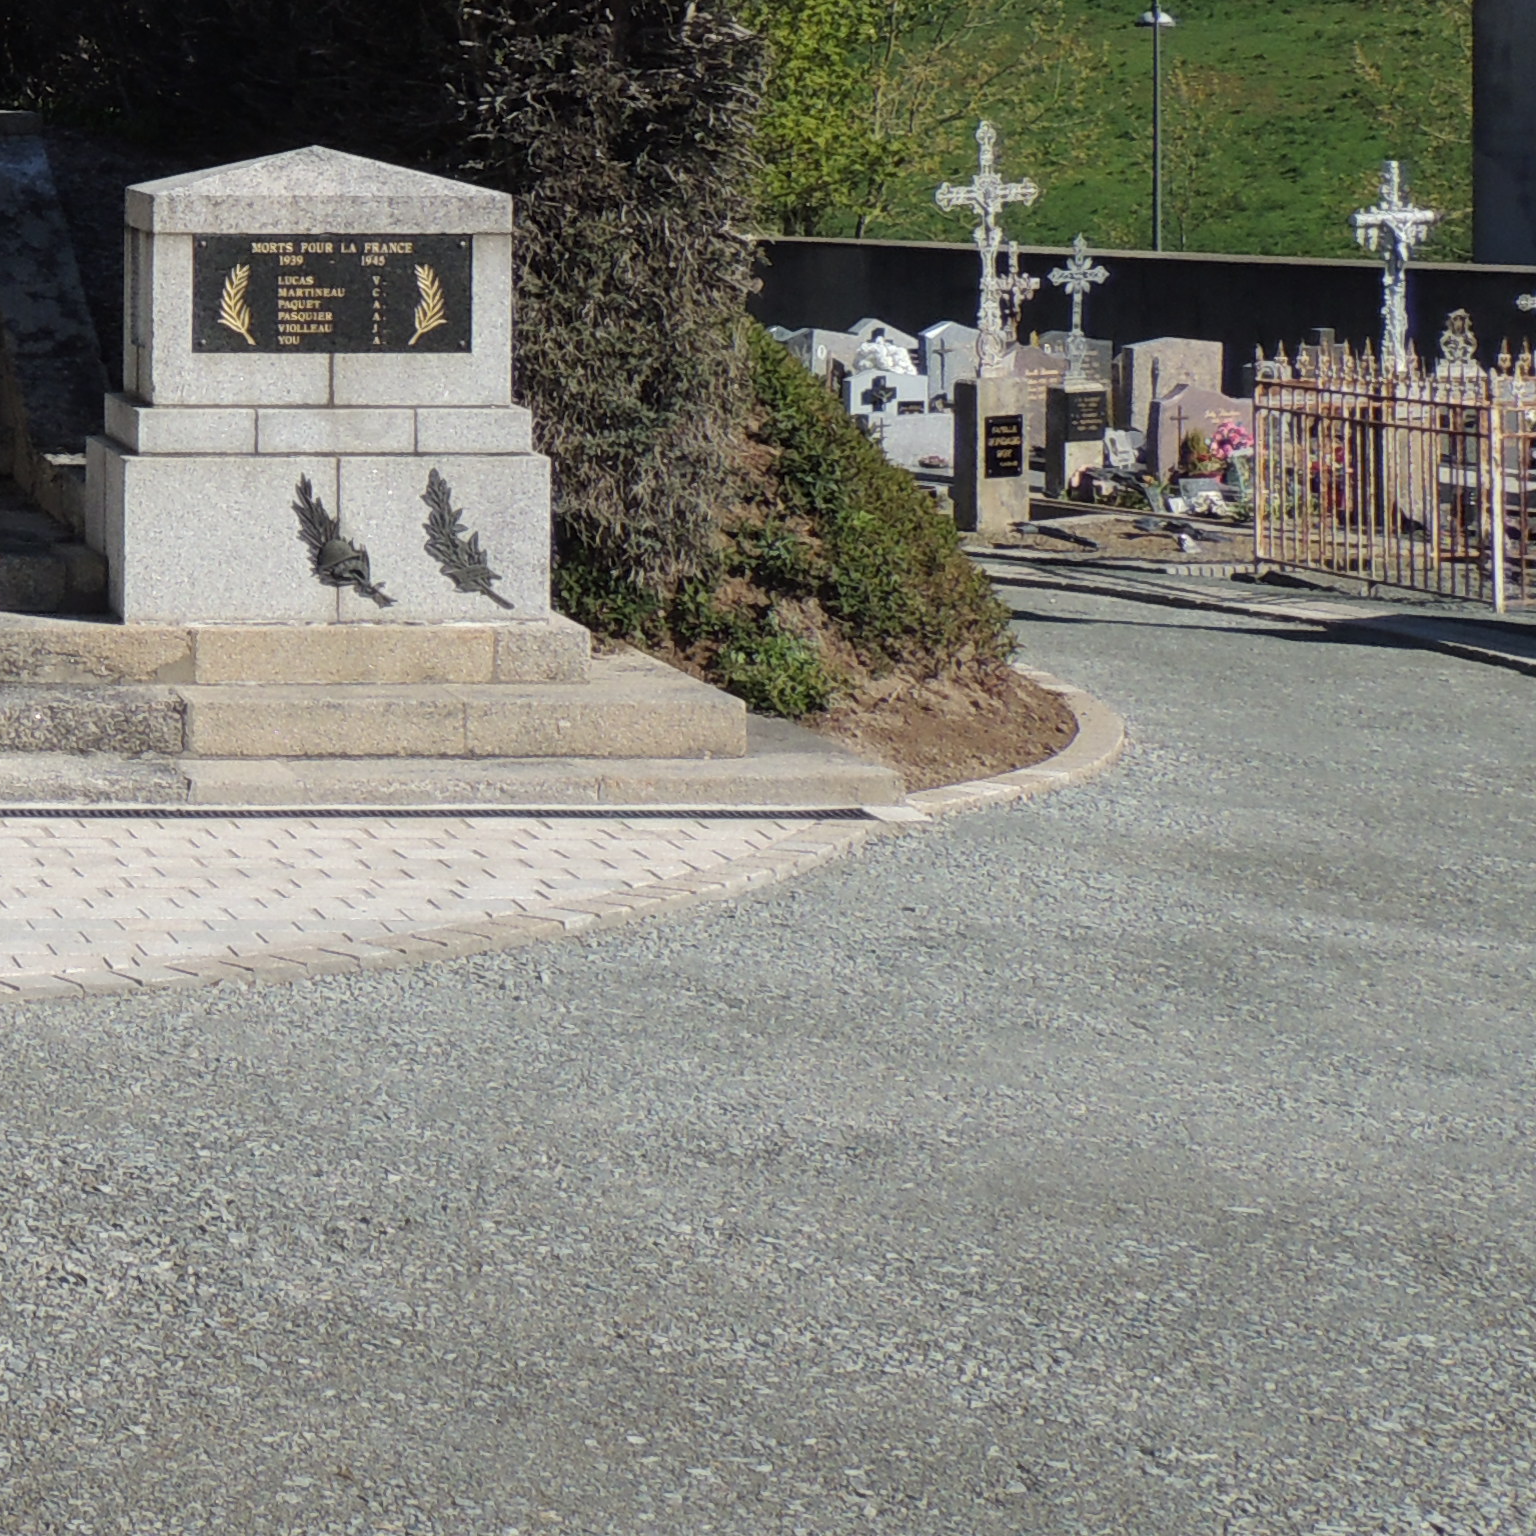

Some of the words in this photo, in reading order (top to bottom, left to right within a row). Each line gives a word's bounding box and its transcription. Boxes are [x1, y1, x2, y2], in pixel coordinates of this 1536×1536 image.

[252, 243, 293, 253] MORTS
[300, 243, 333, 253] POUR
[341, 243, 356, 253] LA
[364, 243, 412, 253] FRANCE
[279, 256, 303, 265] 1939
[361, 256, 385, 266] 1945
[278, 276, 314, 284] LUCAS
[278, 288, 345, 296] MARTINEAU
[278, 300, 321, 309] PAQUET
[278, 312, 333, 322] PASQUIER
[278, 324, 332, 332] VIOLLEAU
[278, 335, 300, 344] YOU
